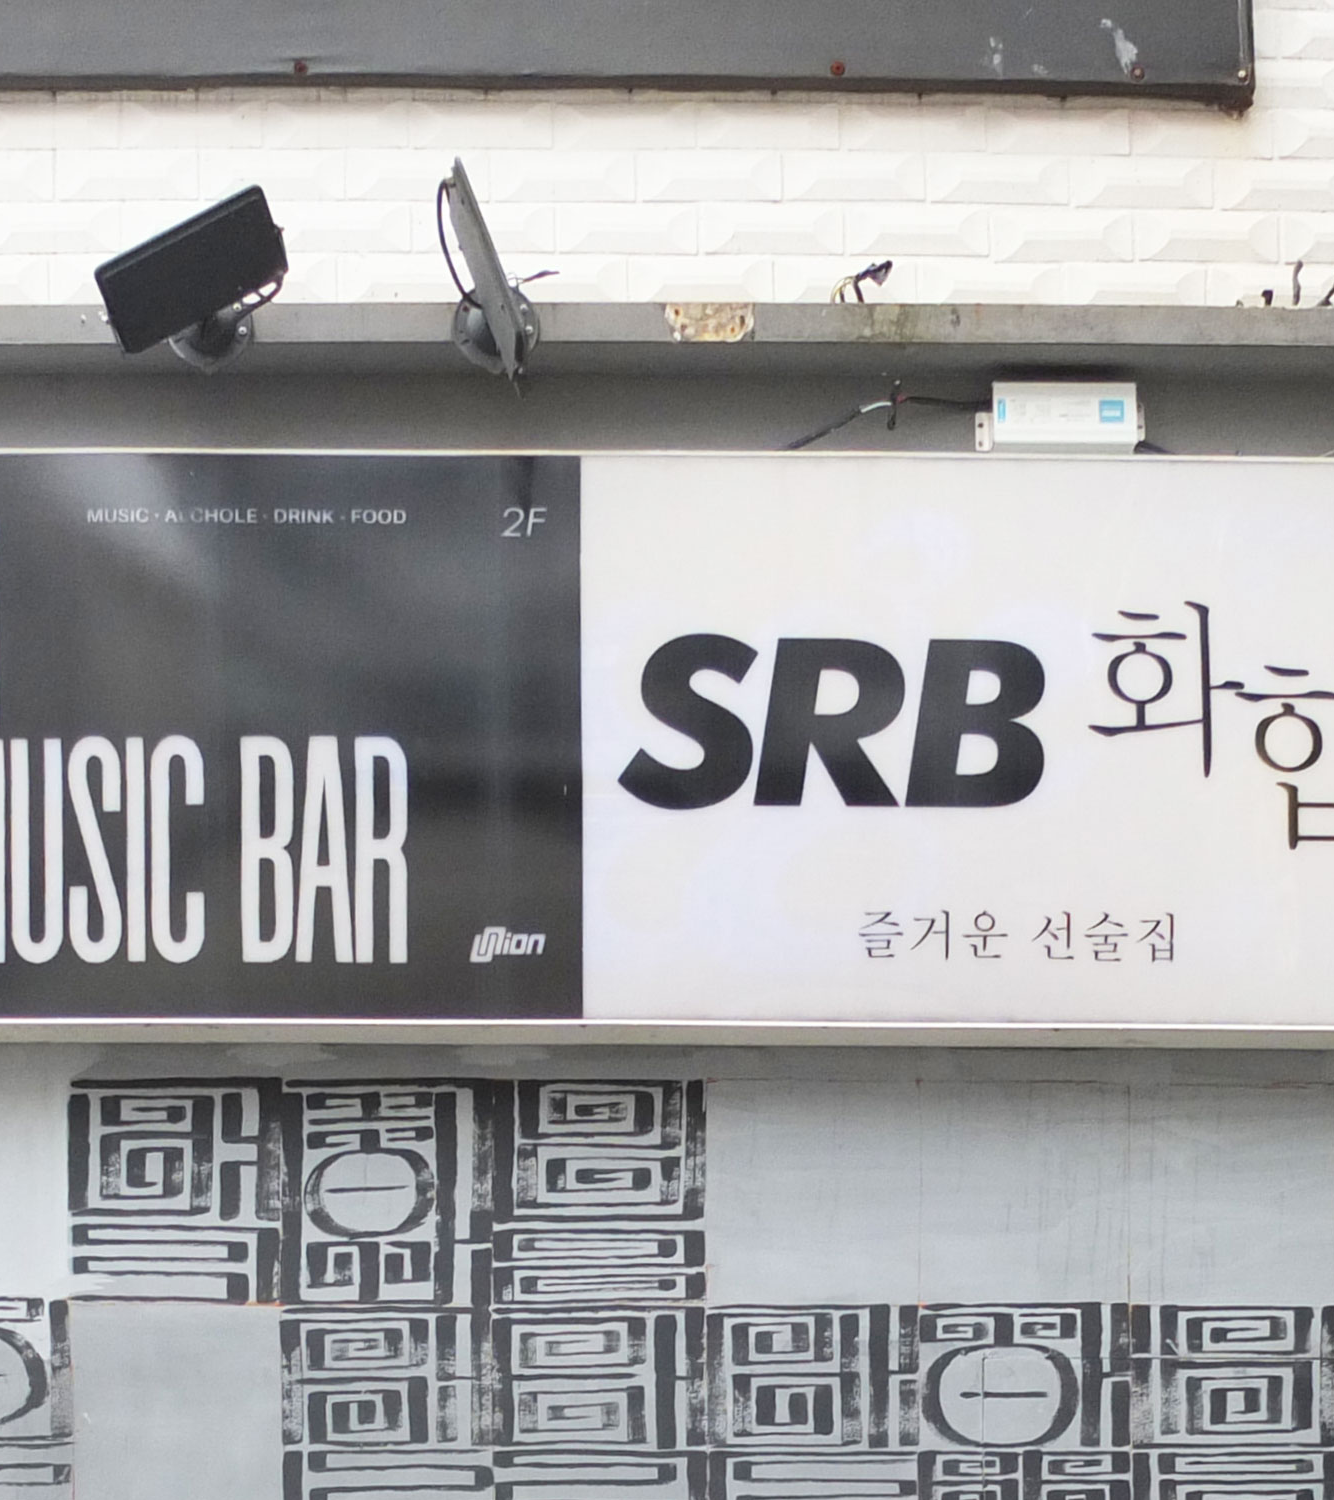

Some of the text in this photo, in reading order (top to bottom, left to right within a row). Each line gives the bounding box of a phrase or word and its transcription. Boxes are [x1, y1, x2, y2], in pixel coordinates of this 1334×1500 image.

[86, 508, 149, 524] MUSIC
[273, 508, 334, 525] DRINK
[351, 509, 407, 525] FOOD
[501, 506, 548, 538] 2F
[617, 632, 1046, 811] SRB
[240, 735, 409, 964] BAR
[858, 909, 1177, 963] 즐거운 선술집
